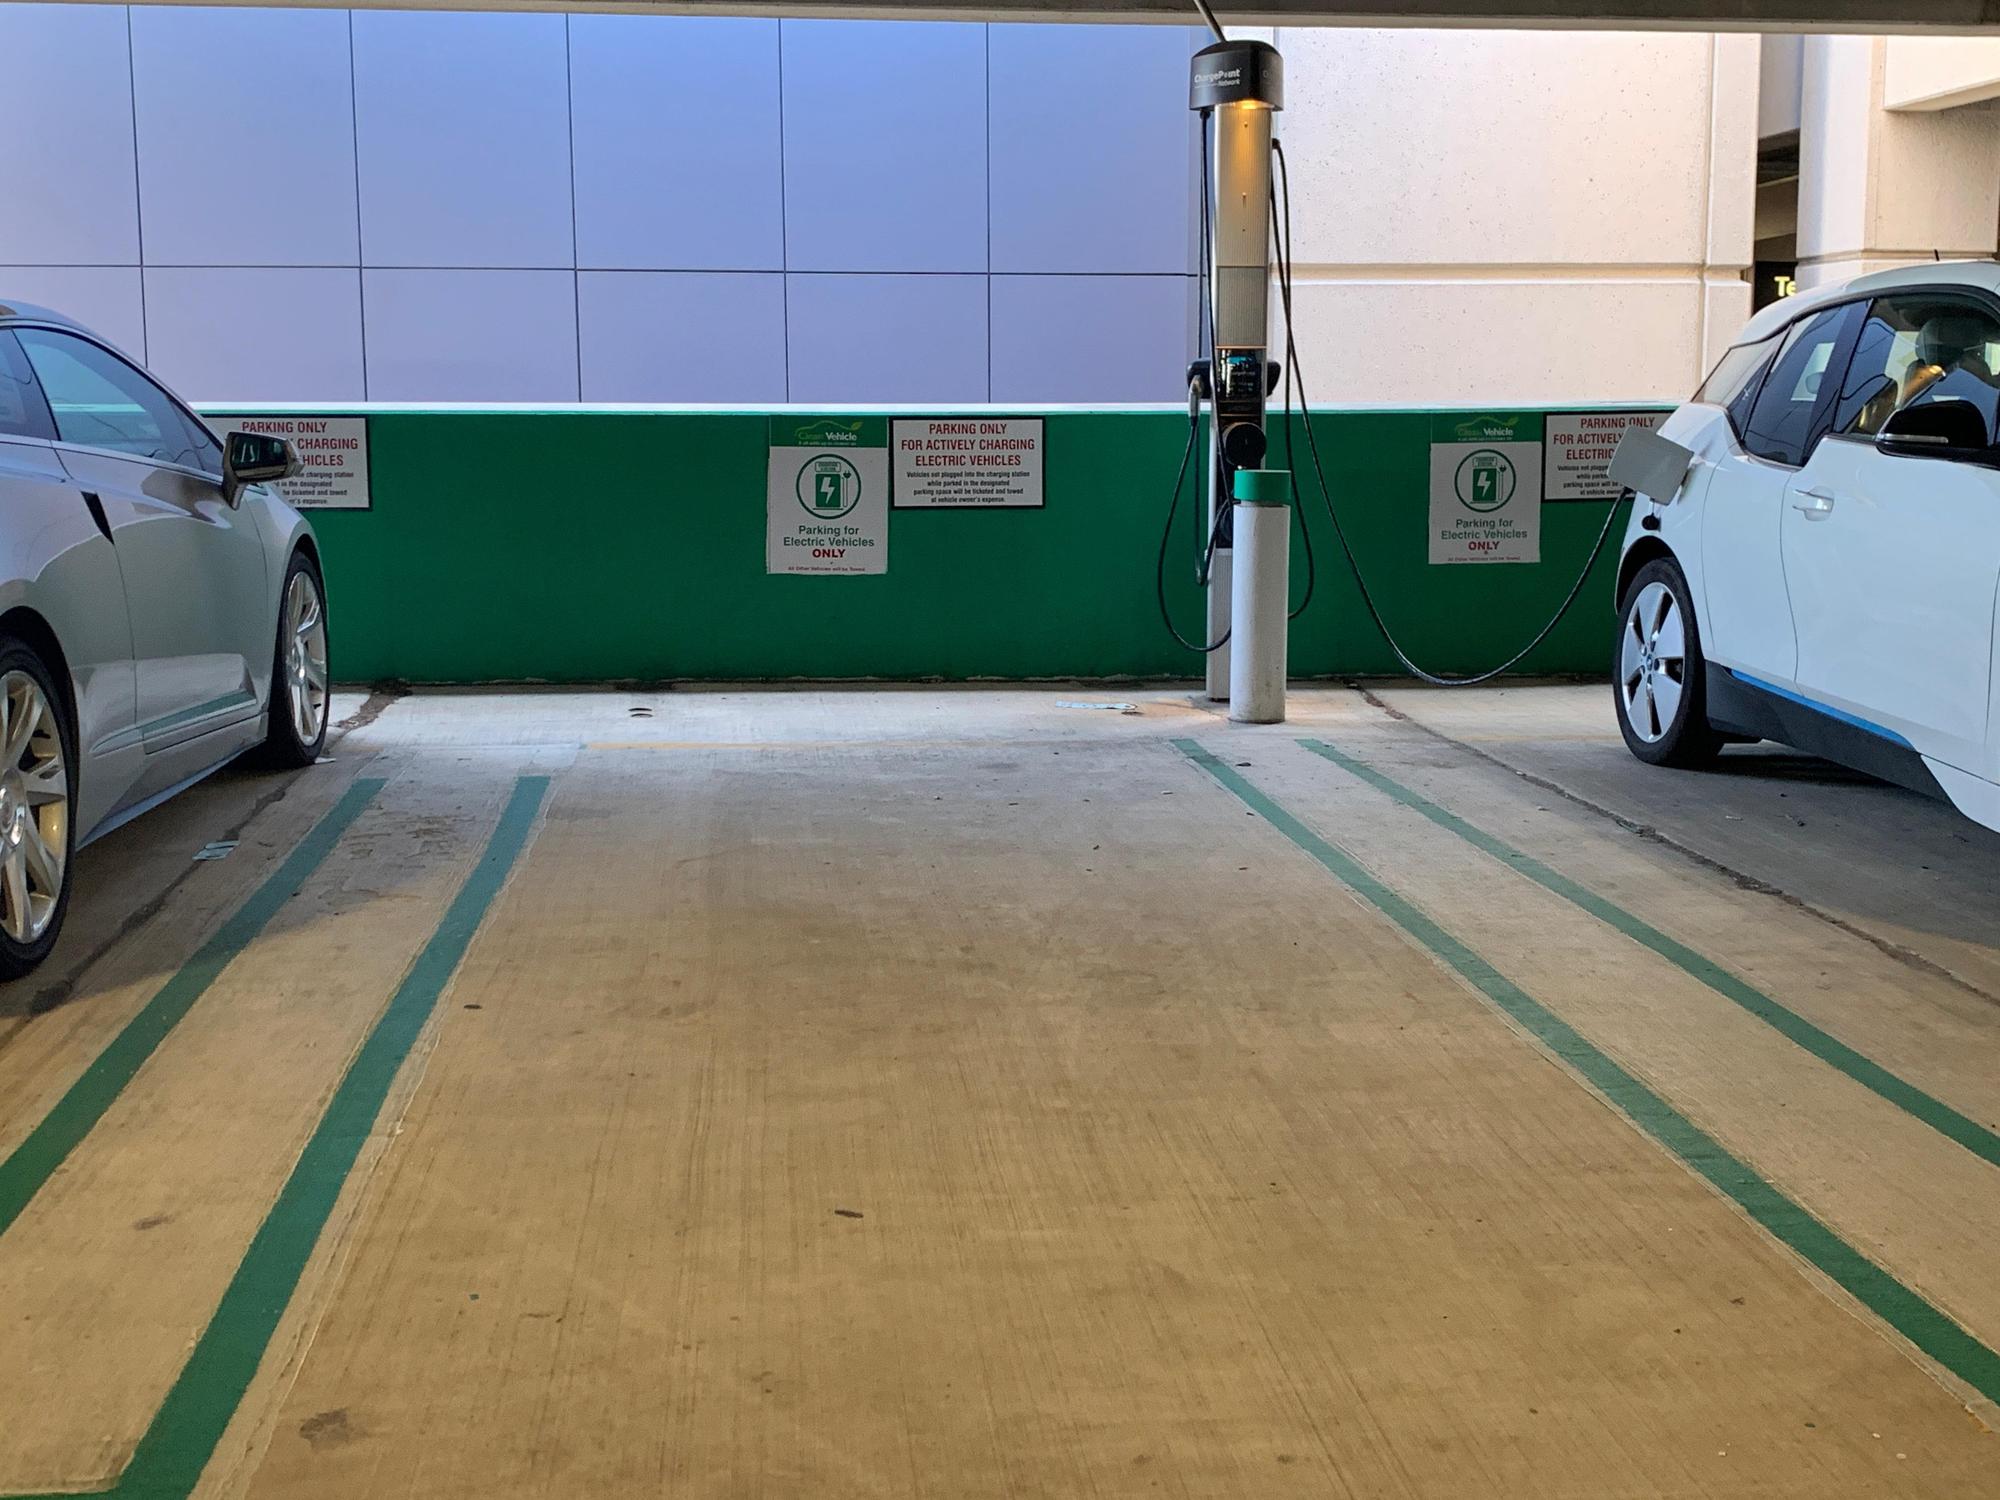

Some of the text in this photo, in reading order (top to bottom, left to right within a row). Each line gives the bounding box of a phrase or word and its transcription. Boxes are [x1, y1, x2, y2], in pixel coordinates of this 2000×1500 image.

[242, 422, 327, 433] PARKING ONLY
[1581, 417, 1655, 428] PARKING ONLY
[929, 424, 1007, 434] PARKING ONLY
[1483, 428, 1513, 436] Vehicle
[825, 432, 857, 440] Vehicle
[1554, 434, 1574, 444] FOR
[298, 438, 358, 449] CHARGING
[902, 439, 1034, 450] FOR ACTIVELY CHARGING
[1566, 449, 1615, 460] ELECTRIC
[302, 455, 344, 466] HICLES
[916, 455, 1021, 466] ELECTRIC VEHICLES
[1456, 518, 1513, 529] Parking for
[799, 525, 859, 536] Parking for
[1441, 530, 1528, 540] Electric Vehicles
[783, 537, 874, 547] Electric Vehicles
[1468, 541, 1500, 550] ONLY
[812, 549, 846, 558] ONLY
